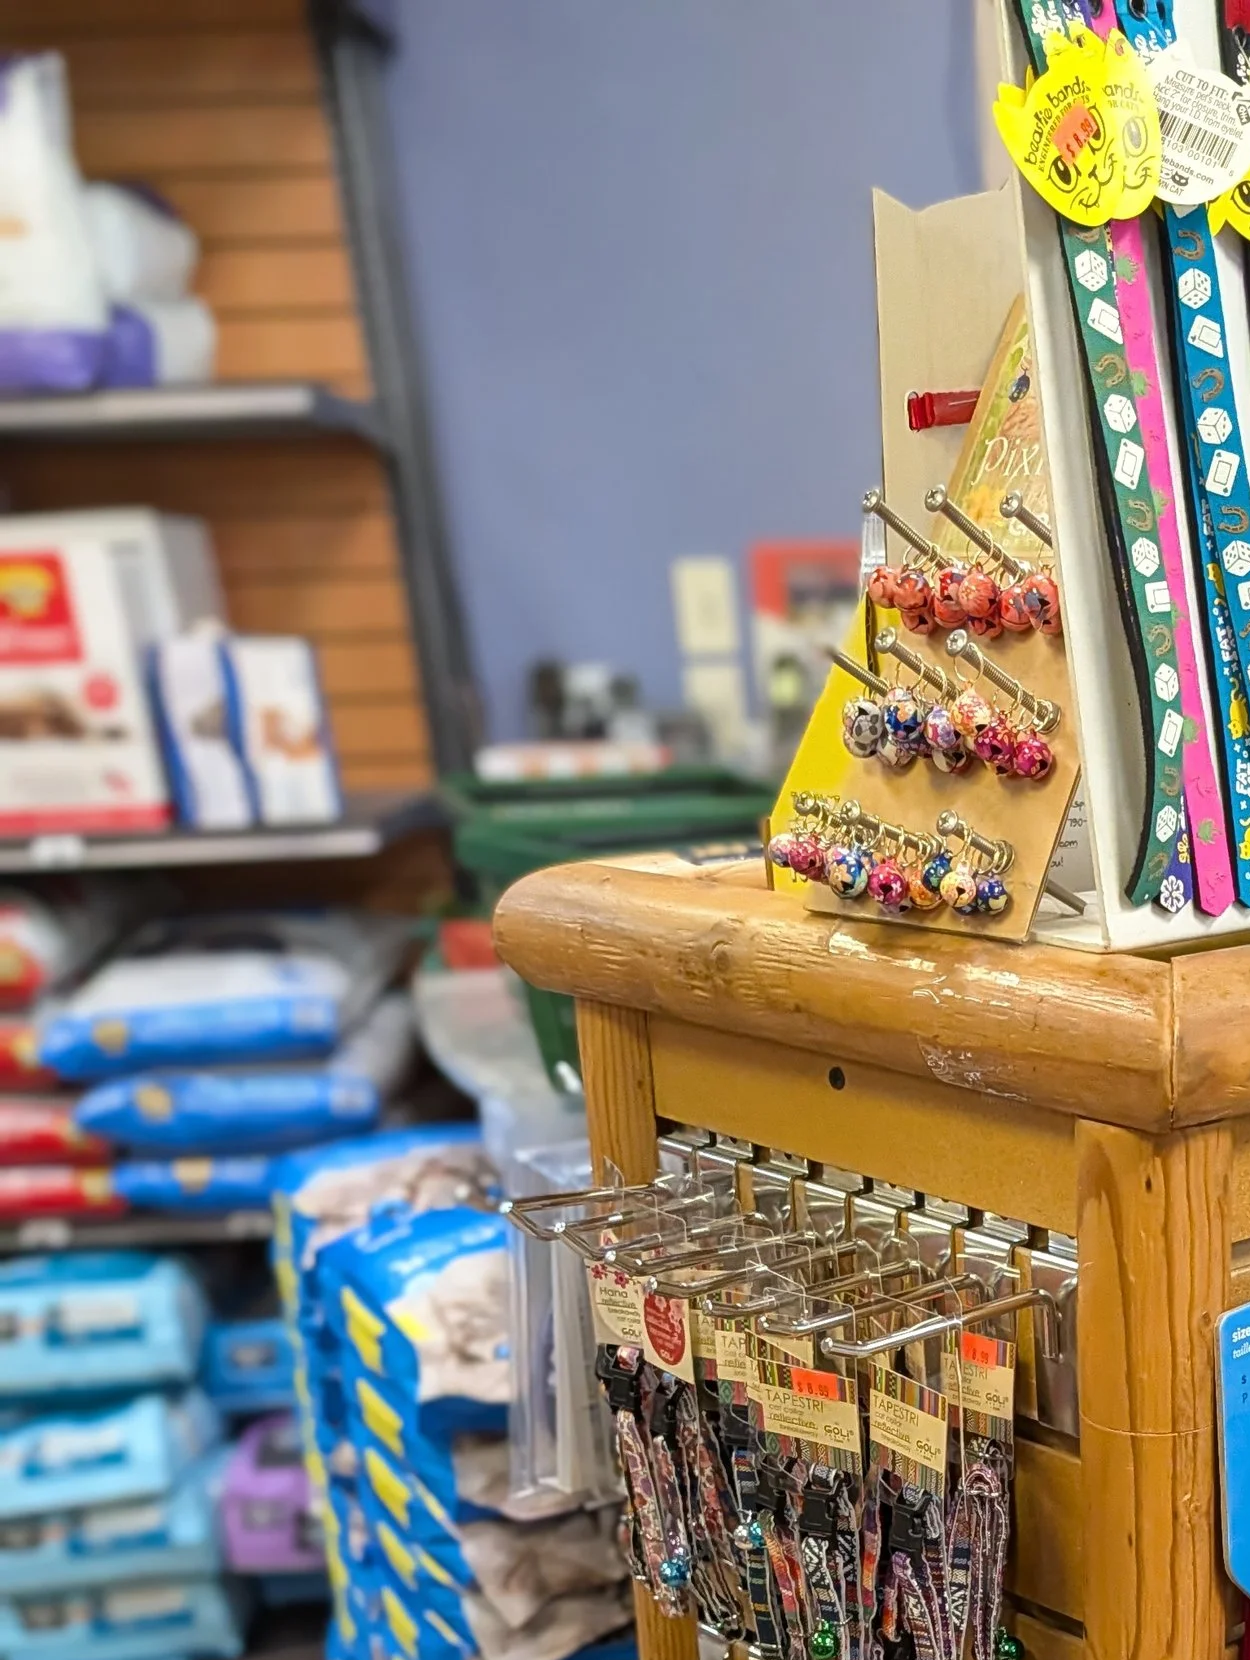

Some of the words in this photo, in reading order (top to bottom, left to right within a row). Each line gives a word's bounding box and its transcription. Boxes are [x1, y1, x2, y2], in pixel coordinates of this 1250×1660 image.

[1164, 75, 1195, 95] Measure
[1175, 69, 1195, 85] CUT
[1198, 78, 1210, 92] TO
[1211, 84, 1229, 101] FIT:
[1180, 91, 1190, 103] for
[1024, 106, 1053, 166] beastie
[1046, 75, 1086, 108] bands
[1171, 100, 1188, 116] your
[1203, 113, 1219, 128] from
[1187, 150, 1218, 168] 00101
[1169, 181, 1185, 197] CAT
[1236, 757, 1250, 796] FAT
[599, 1286, 628, 1299] Hana
[943, 1357, 988, 1381] TAESTRI
[766, 1389, 824, 1414] TAPESTRI
[873, 1394, 919, 1427] TAPESTRI
